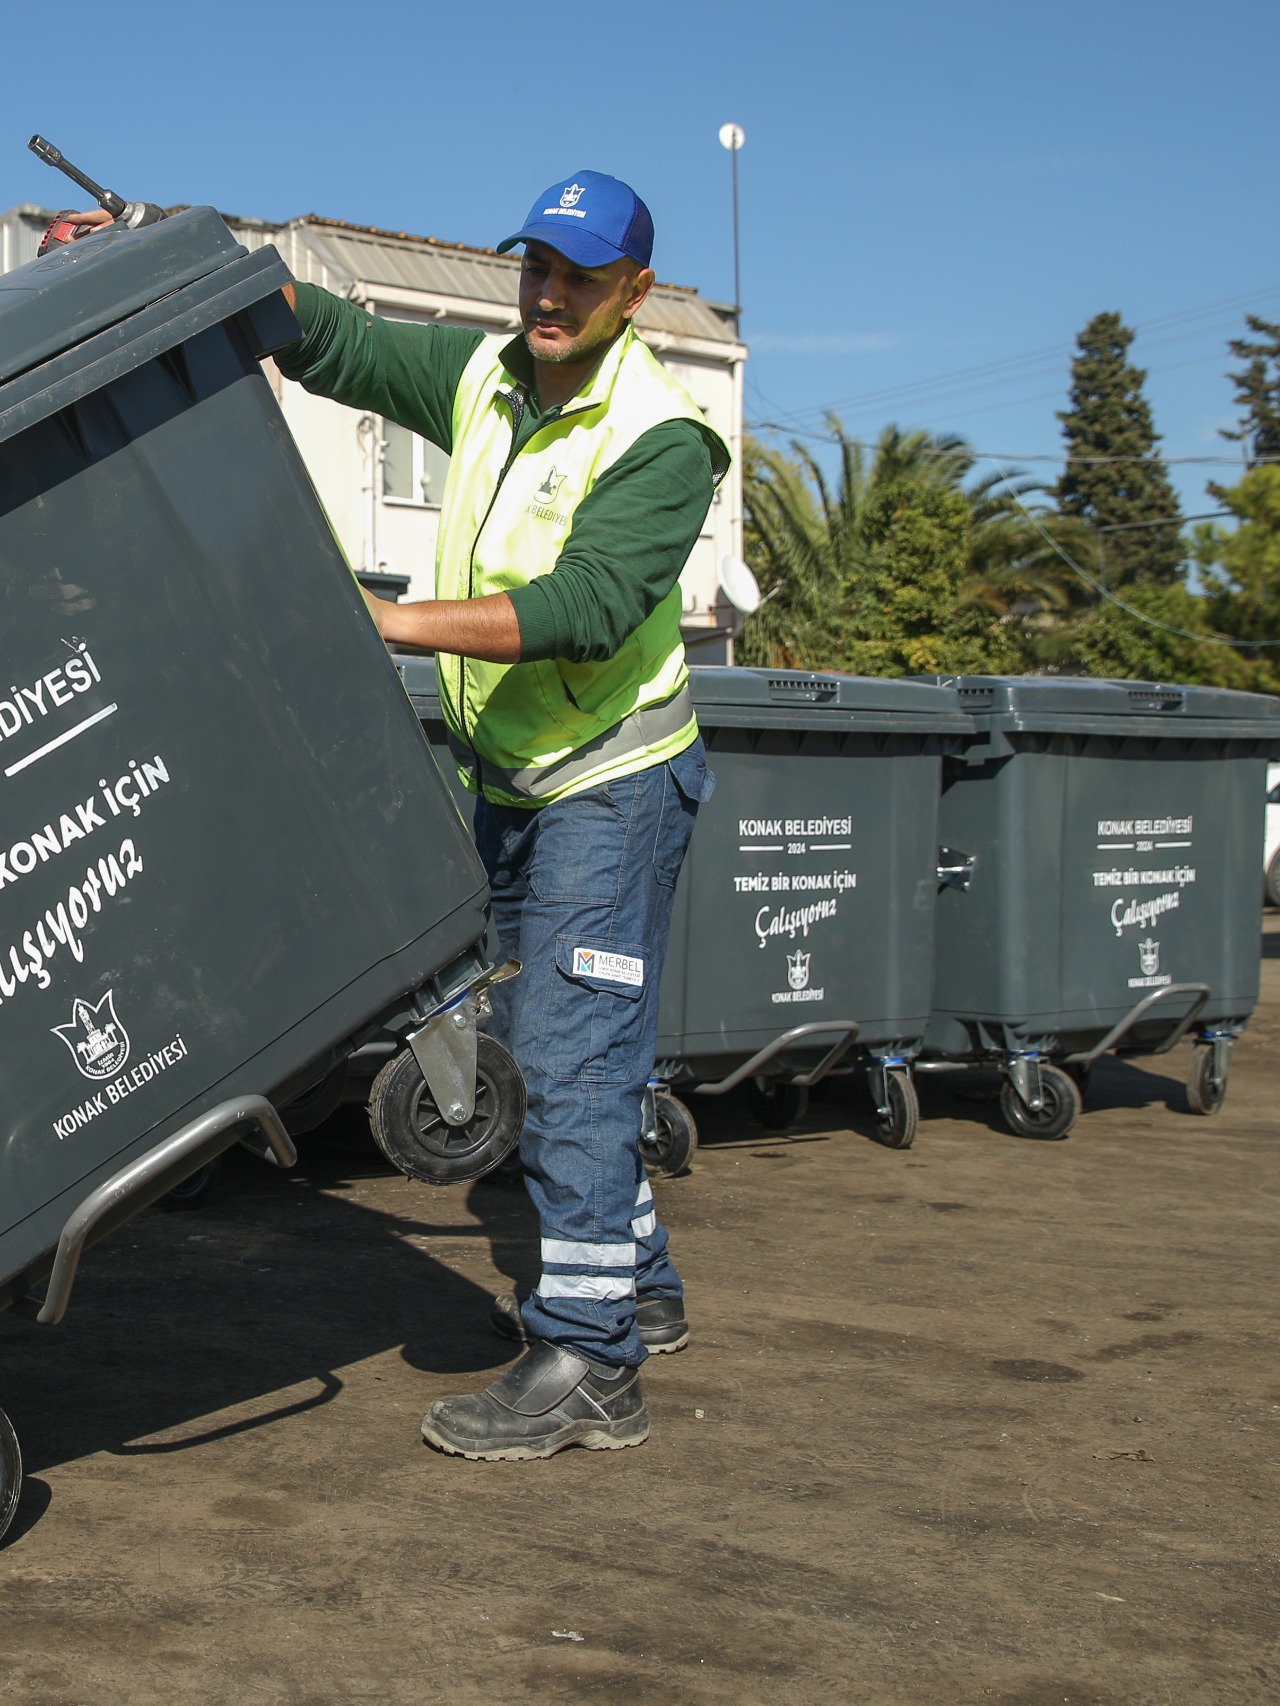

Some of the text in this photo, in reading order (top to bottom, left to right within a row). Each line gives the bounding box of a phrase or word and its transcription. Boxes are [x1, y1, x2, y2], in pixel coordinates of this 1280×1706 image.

[98, 756, 171, 817] İÇİN
[739, 816, 852, 836] KONAK BELEDİYESİ
[1097, 816, 1193, 835] KONAK BELEDİYESİ
[788, 842, 806, 854] 2024
[733, 870, 856, 893] TEMİZ BİR KONAK İÇİN
[1093, 865, 1196, 887] TEMİZ BİR KONAK İÇİN
[599, 955, 641, 973] MERBEL
[52, 1033, 188, 1141] KONAK BELEDİYESİ
